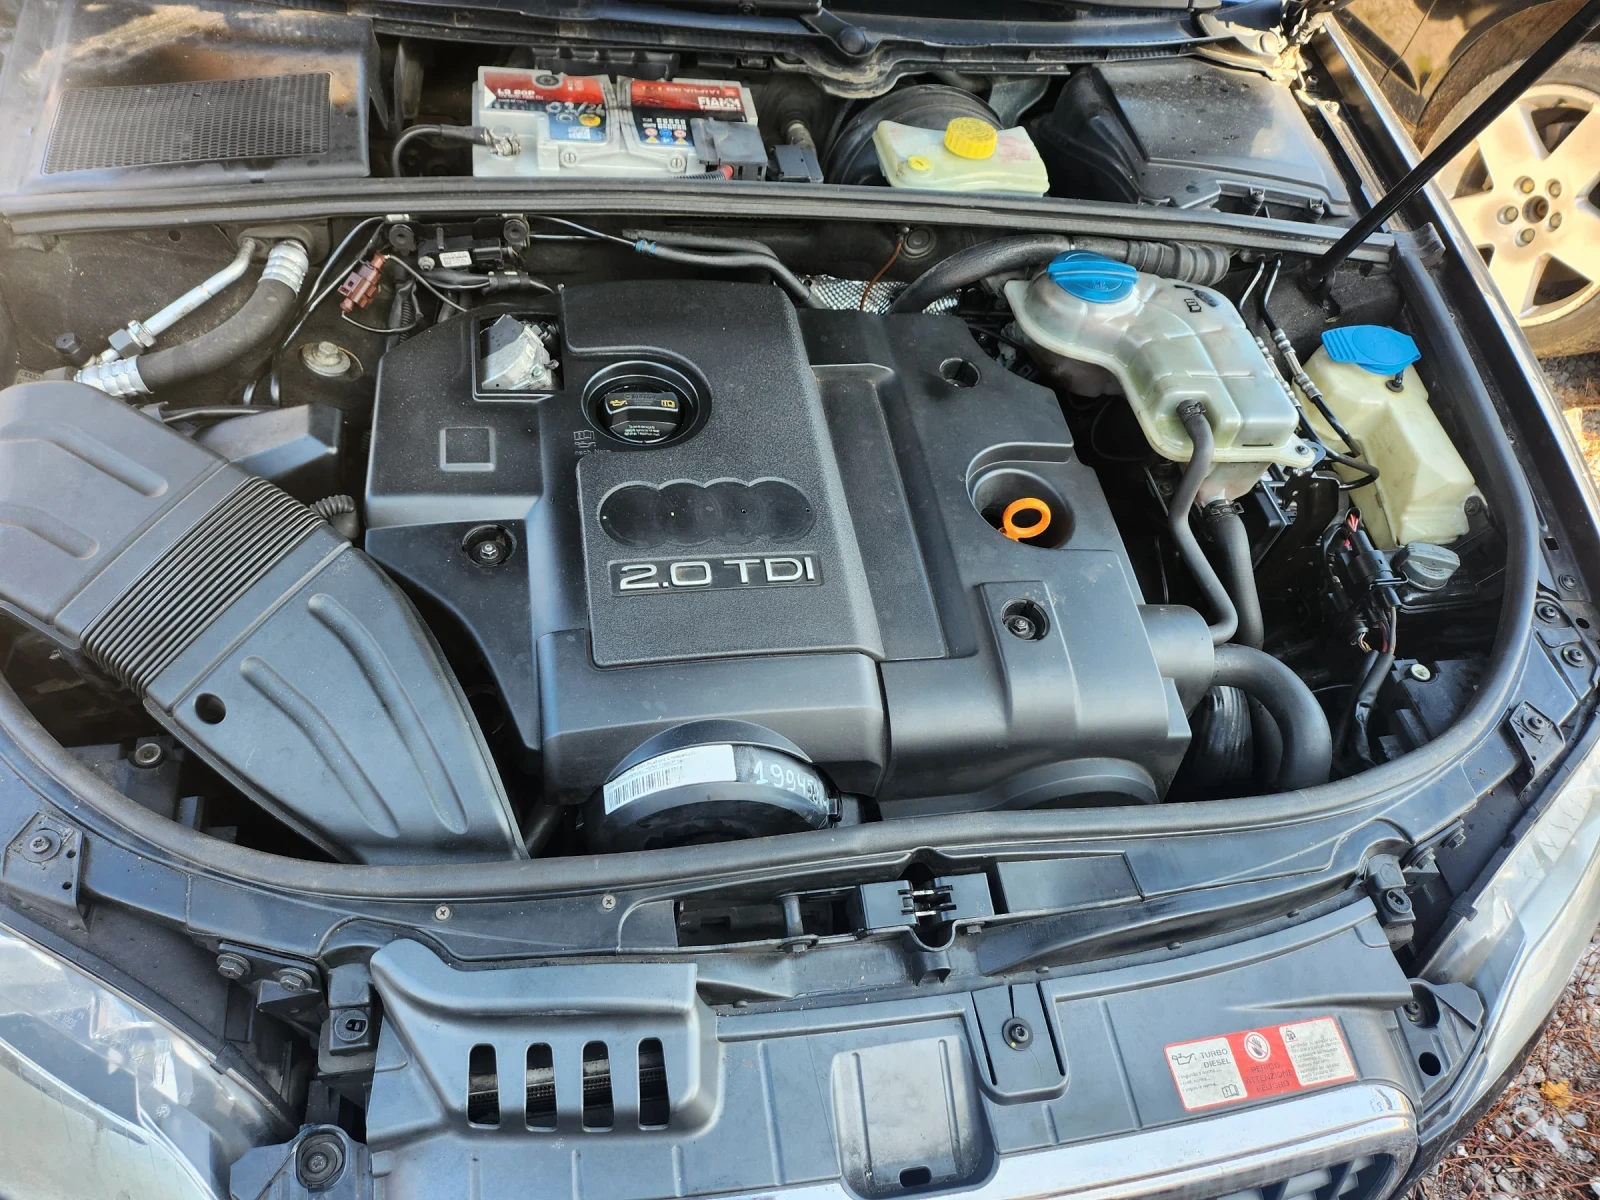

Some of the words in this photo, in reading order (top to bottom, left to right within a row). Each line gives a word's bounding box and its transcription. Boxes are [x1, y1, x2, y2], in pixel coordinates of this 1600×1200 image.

[697, 96, 741, 108] FIAMM
[620, 561, 713, 591] 2.0
[723, 556, 815, 584] TDI
[1200, 1048, 1228, 1060] TURBO
[1203, 1059, 1232, 1069] DIESEL
[1251, 1061, 1281, 1073] PERIGO
[1246, 1069, 1293, 1085] ATTENZIONE
[1256, 1080, 1290, 1093] PELIGRO
